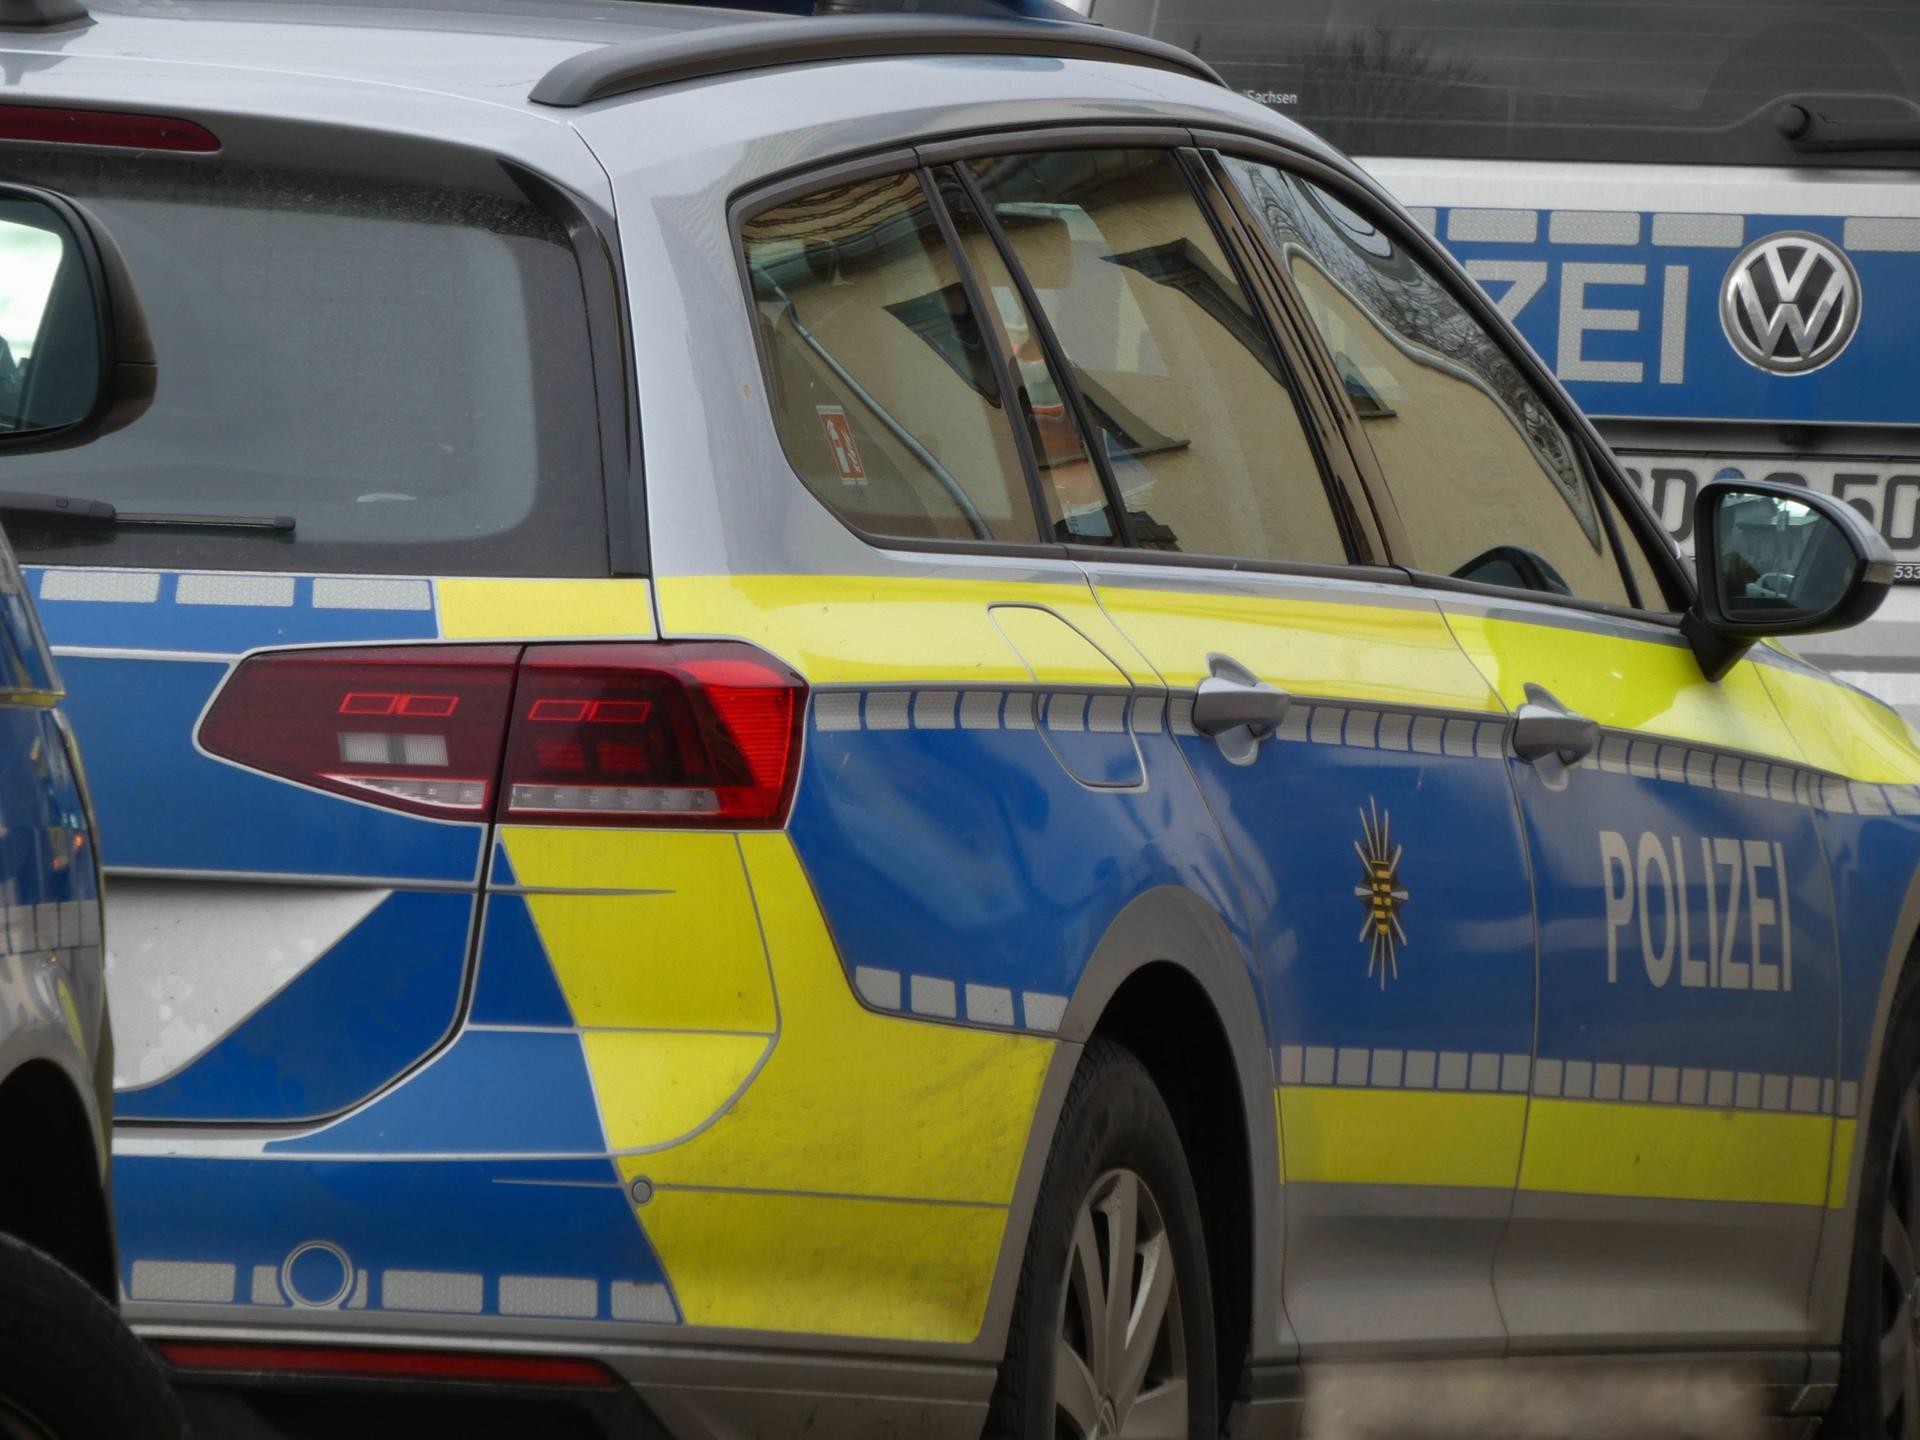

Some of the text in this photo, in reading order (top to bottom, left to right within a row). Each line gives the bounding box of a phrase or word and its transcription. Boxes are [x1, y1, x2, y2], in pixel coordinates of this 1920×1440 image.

[1243, 90, 1297, 104] Sachsen
[1625, 467, 1698, 543] D
[1599, 830, 1792, 991] POLIZEI
